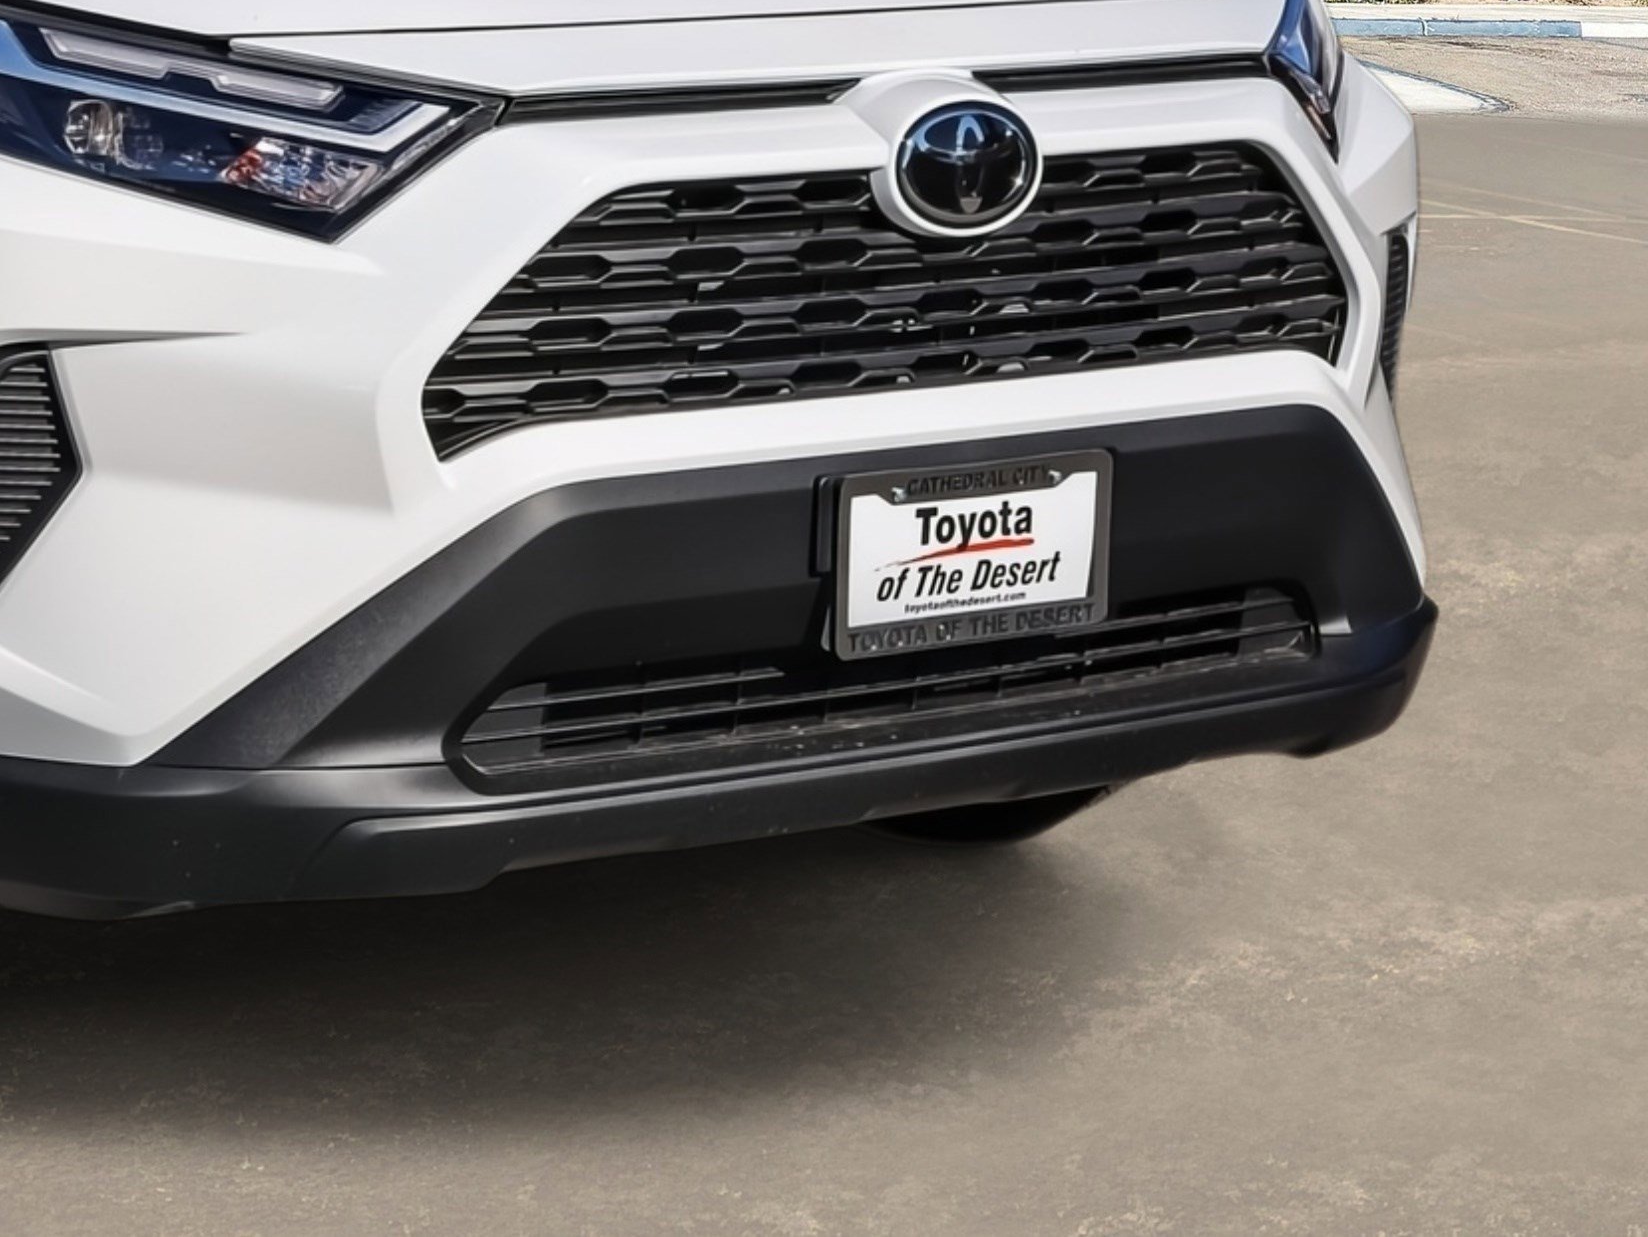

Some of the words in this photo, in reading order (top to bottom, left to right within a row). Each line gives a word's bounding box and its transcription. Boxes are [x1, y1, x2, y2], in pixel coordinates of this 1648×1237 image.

[906, 470, 1006, 496] CATHEDRAL
[1012, 464, 1051, 486] CITY
[915, 500, 1034, 551] Toyota
[876, 567, 911, 602] of
[914, 564, 964, 598] The
[970, 550, 1061, 592] Desert
[846, 623, 928, 653] TOYOTA
[935, 621, 964, 643] OF
[968, 616, 1009, 637] THE
[1014, 602, 1097, 632] DESERT
